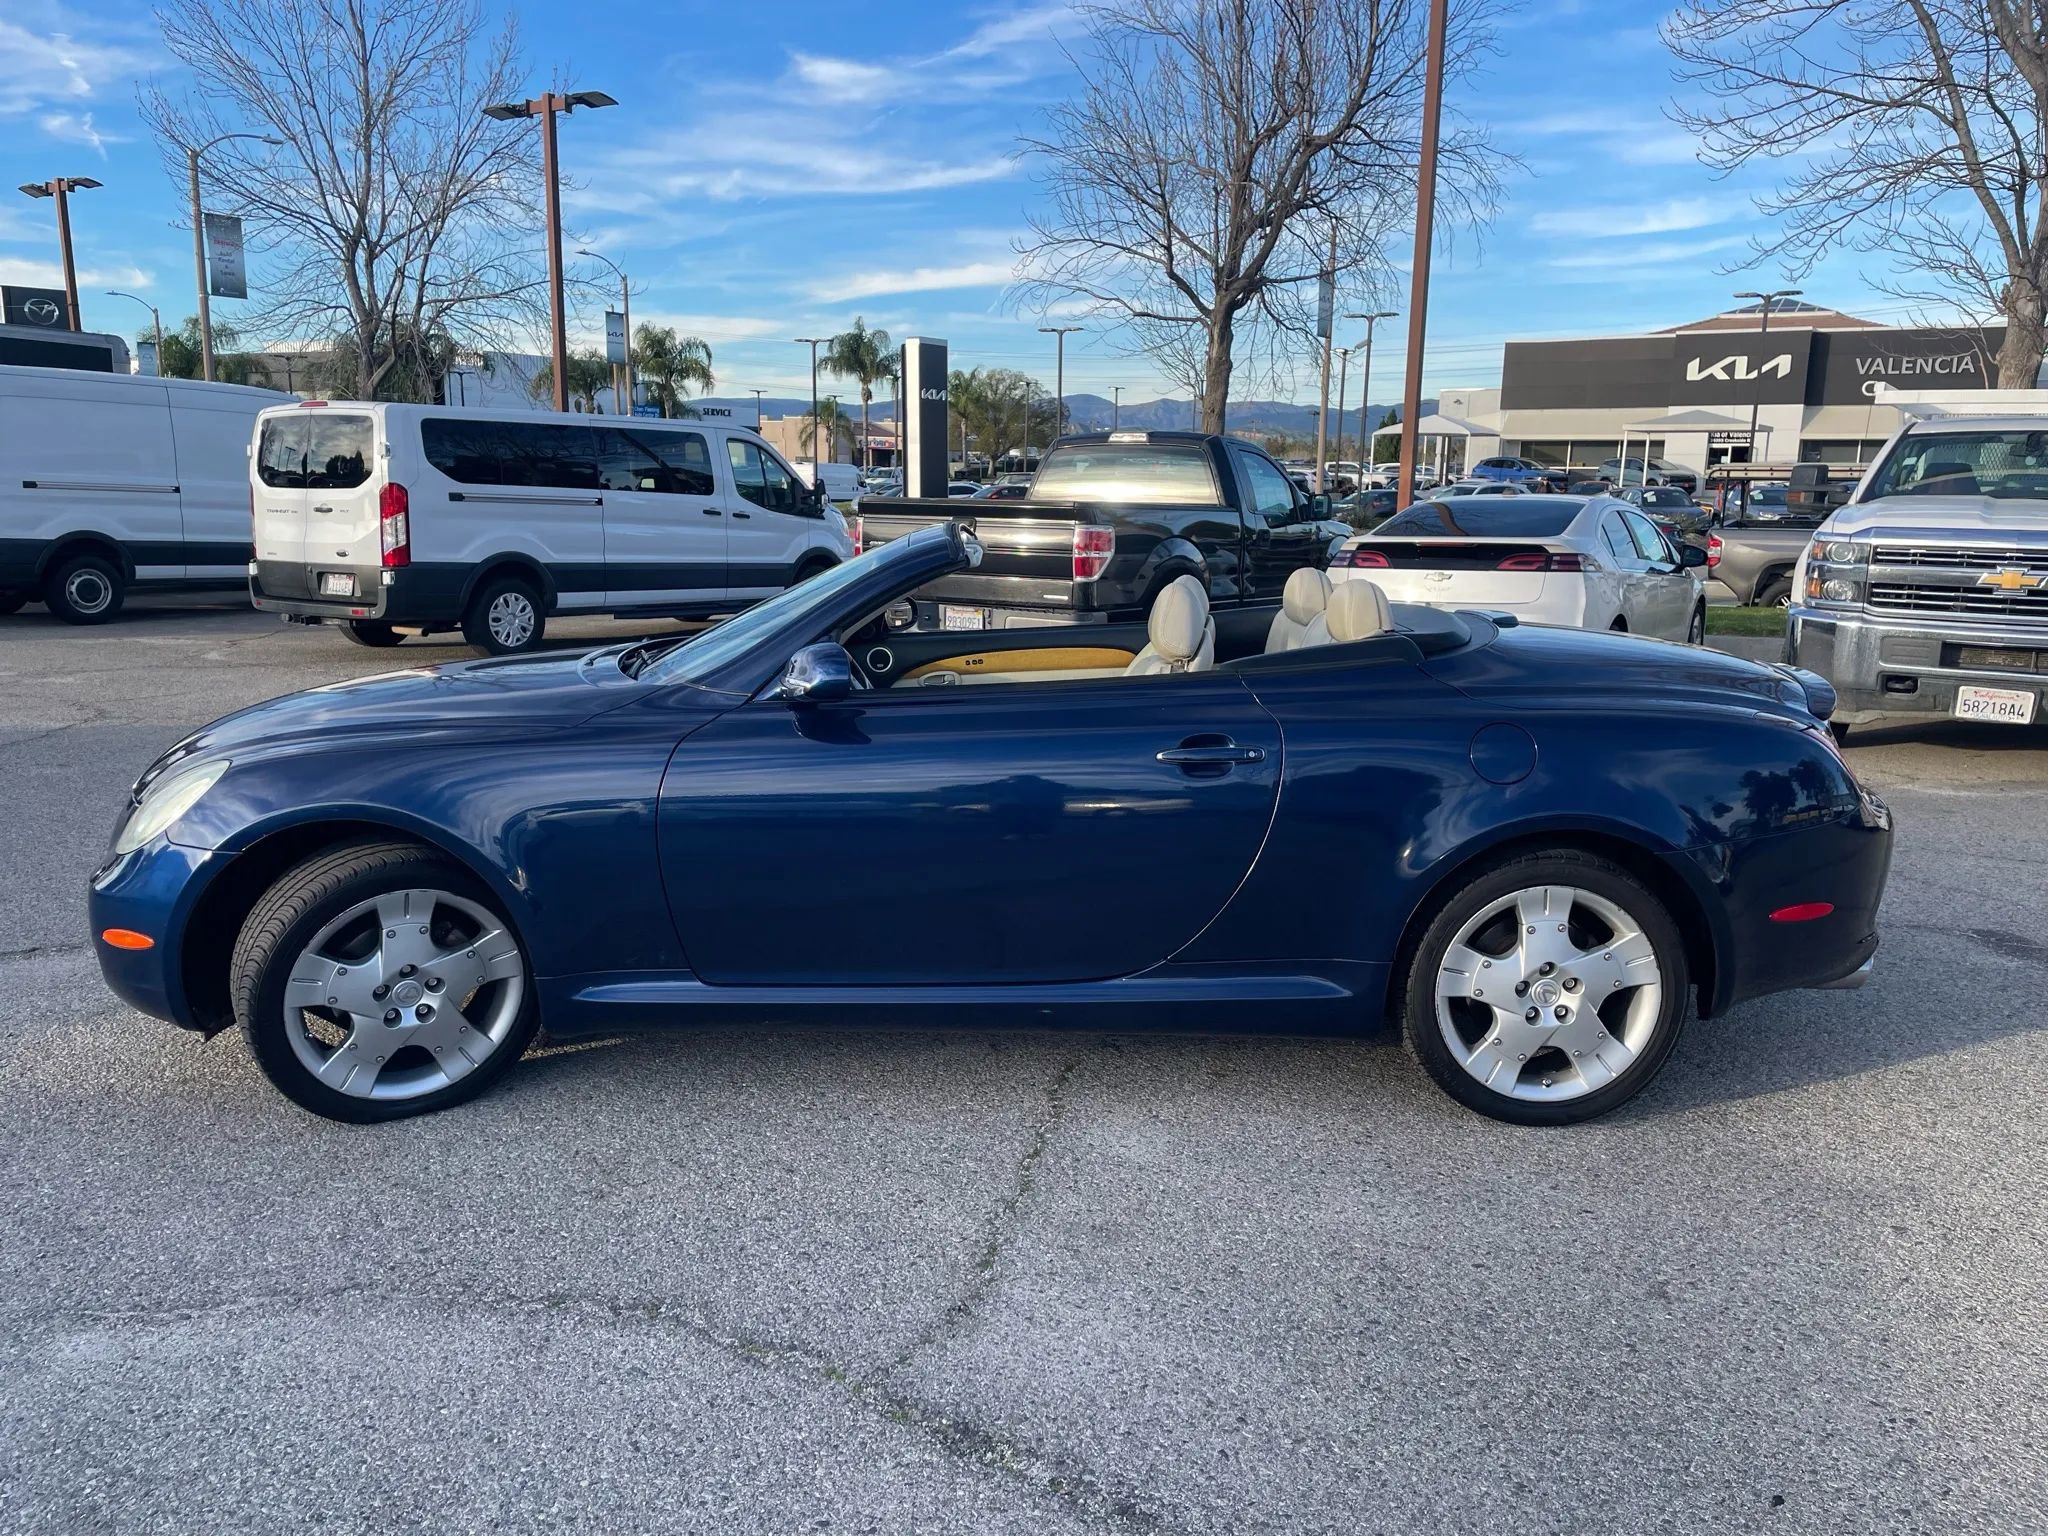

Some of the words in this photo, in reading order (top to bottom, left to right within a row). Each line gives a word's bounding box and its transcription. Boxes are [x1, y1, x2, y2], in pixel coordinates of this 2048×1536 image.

[1686, 354, 1792, 381] KIA
[1855, 356, 1975, 375] VALENCIA
[921, 388, 947, 401] KIA
[702, 408, 731, 417] SERVICE
